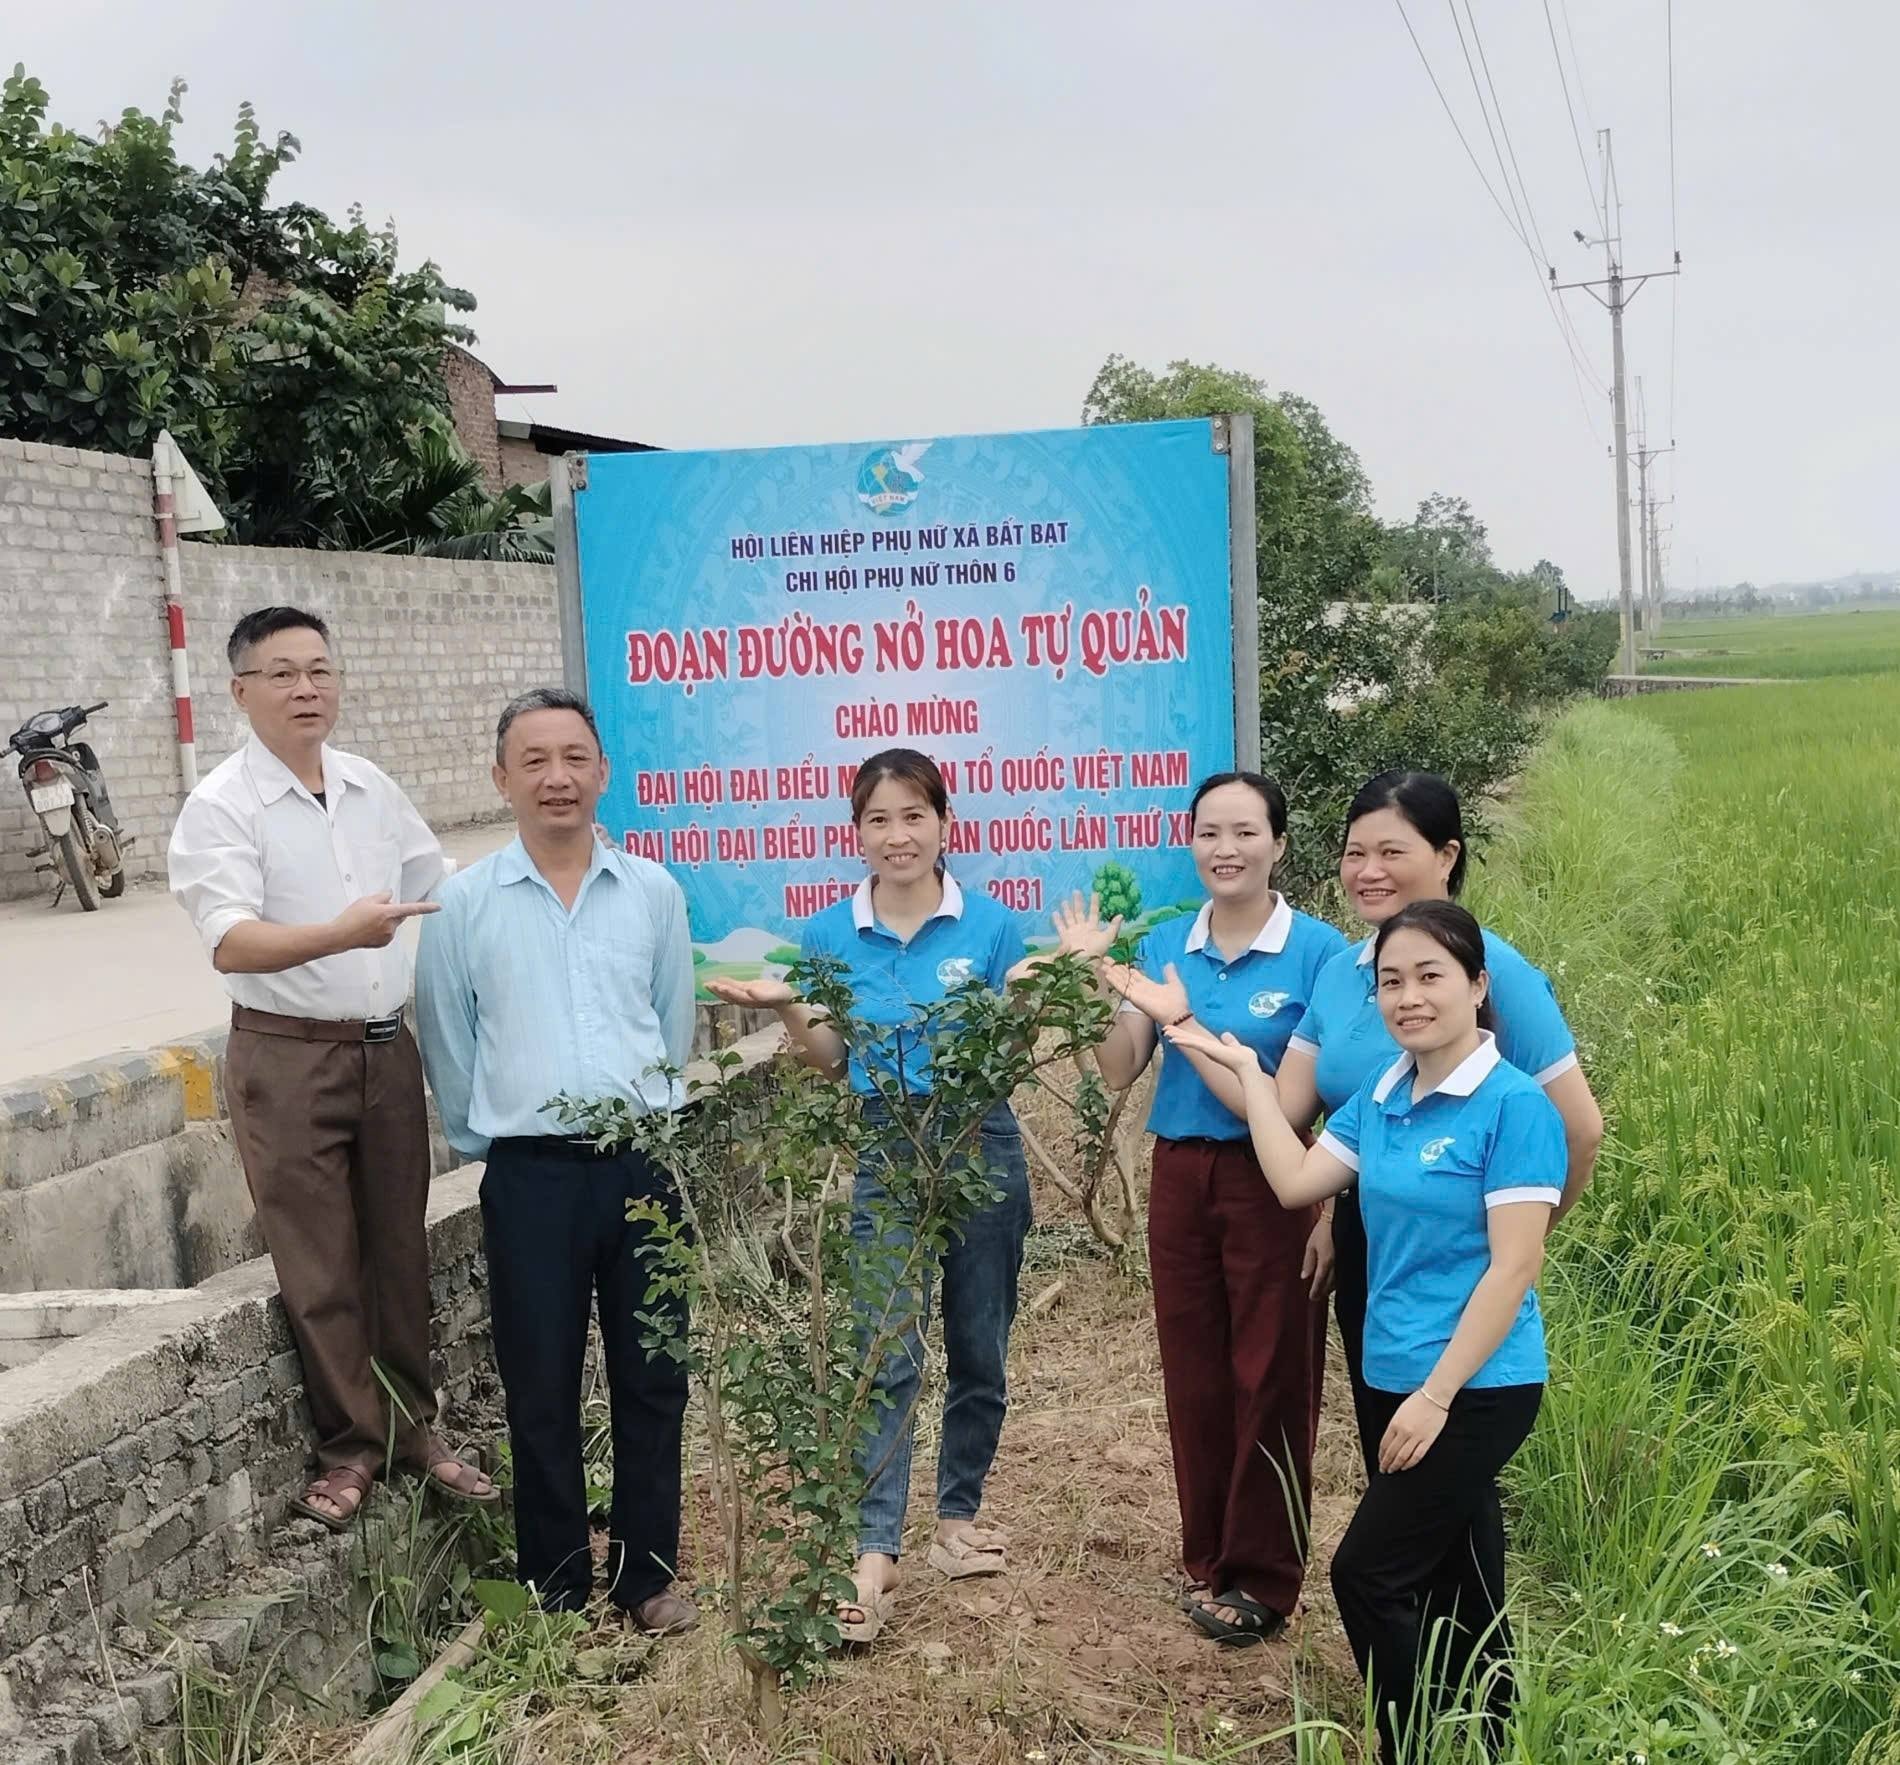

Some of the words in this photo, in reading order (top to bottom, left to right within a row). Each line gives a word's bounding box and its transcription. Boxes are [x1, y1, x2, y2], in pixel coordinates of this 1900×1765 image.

[732, 533, 764, 563] HỘI
[770, 531, 814, 557] LIÊN
[820, 529, 865, 558] HIỆP
[872, 530, 911, 556] PHỤ
[918, 524, 948, 550] NỮ
[953, 522, 980, 548] XÃ
[986, 517, 1024, 546] BẤT
[1030, 522, 1068, 548] BẠT
[786, 571, 818, 593] CHI
[825, 565, 857, 595] HỘI
[864, 567, 904, 592] PHỤ
[911, 561, 940, 586] NỮ
[945, 559, 997, 585] THÔN
[1003, 561, 1016, 583] 6
[628, 629, 728, 695] ĐOẠN
[738, 611, 865, 678] ĐƯỜNG
[873, 600, 925, 672] NỞ
[934, 617, 1013, 670] HOA
[1021, 604, 1072, 680] TỰ
[1080, 588, 1186, 675] QUẢN
[835, 696, 899, 739] CHÀO
[906, 694, 978, 736] MỪNG
[637, 772, 677, 812] ĐẠI
[684, 763, 723, 811] HỘI
[730, 768, 769, 809] ĐẠI
[776, 752, 829, 800] BIỂU
[964, 746, 994, 794] TỔ
[1001, 746, 1065, 796] QUỐC
[1073, 748, 1124, 796] VIỆT
[1131, 752, 1188, 787] NAM
[671, 823, 710, 870] HỘI
[717, 828, 756, 868] ĐẠI
[763, 813, 816, 860] BIỂU
[989, 806, 1052, 856] QUỐC
[1060, 805, 1106, 850] LẦN
[1114, 807, 1162, 849] THỨ
[988, 879, 1041, 912] 2031
